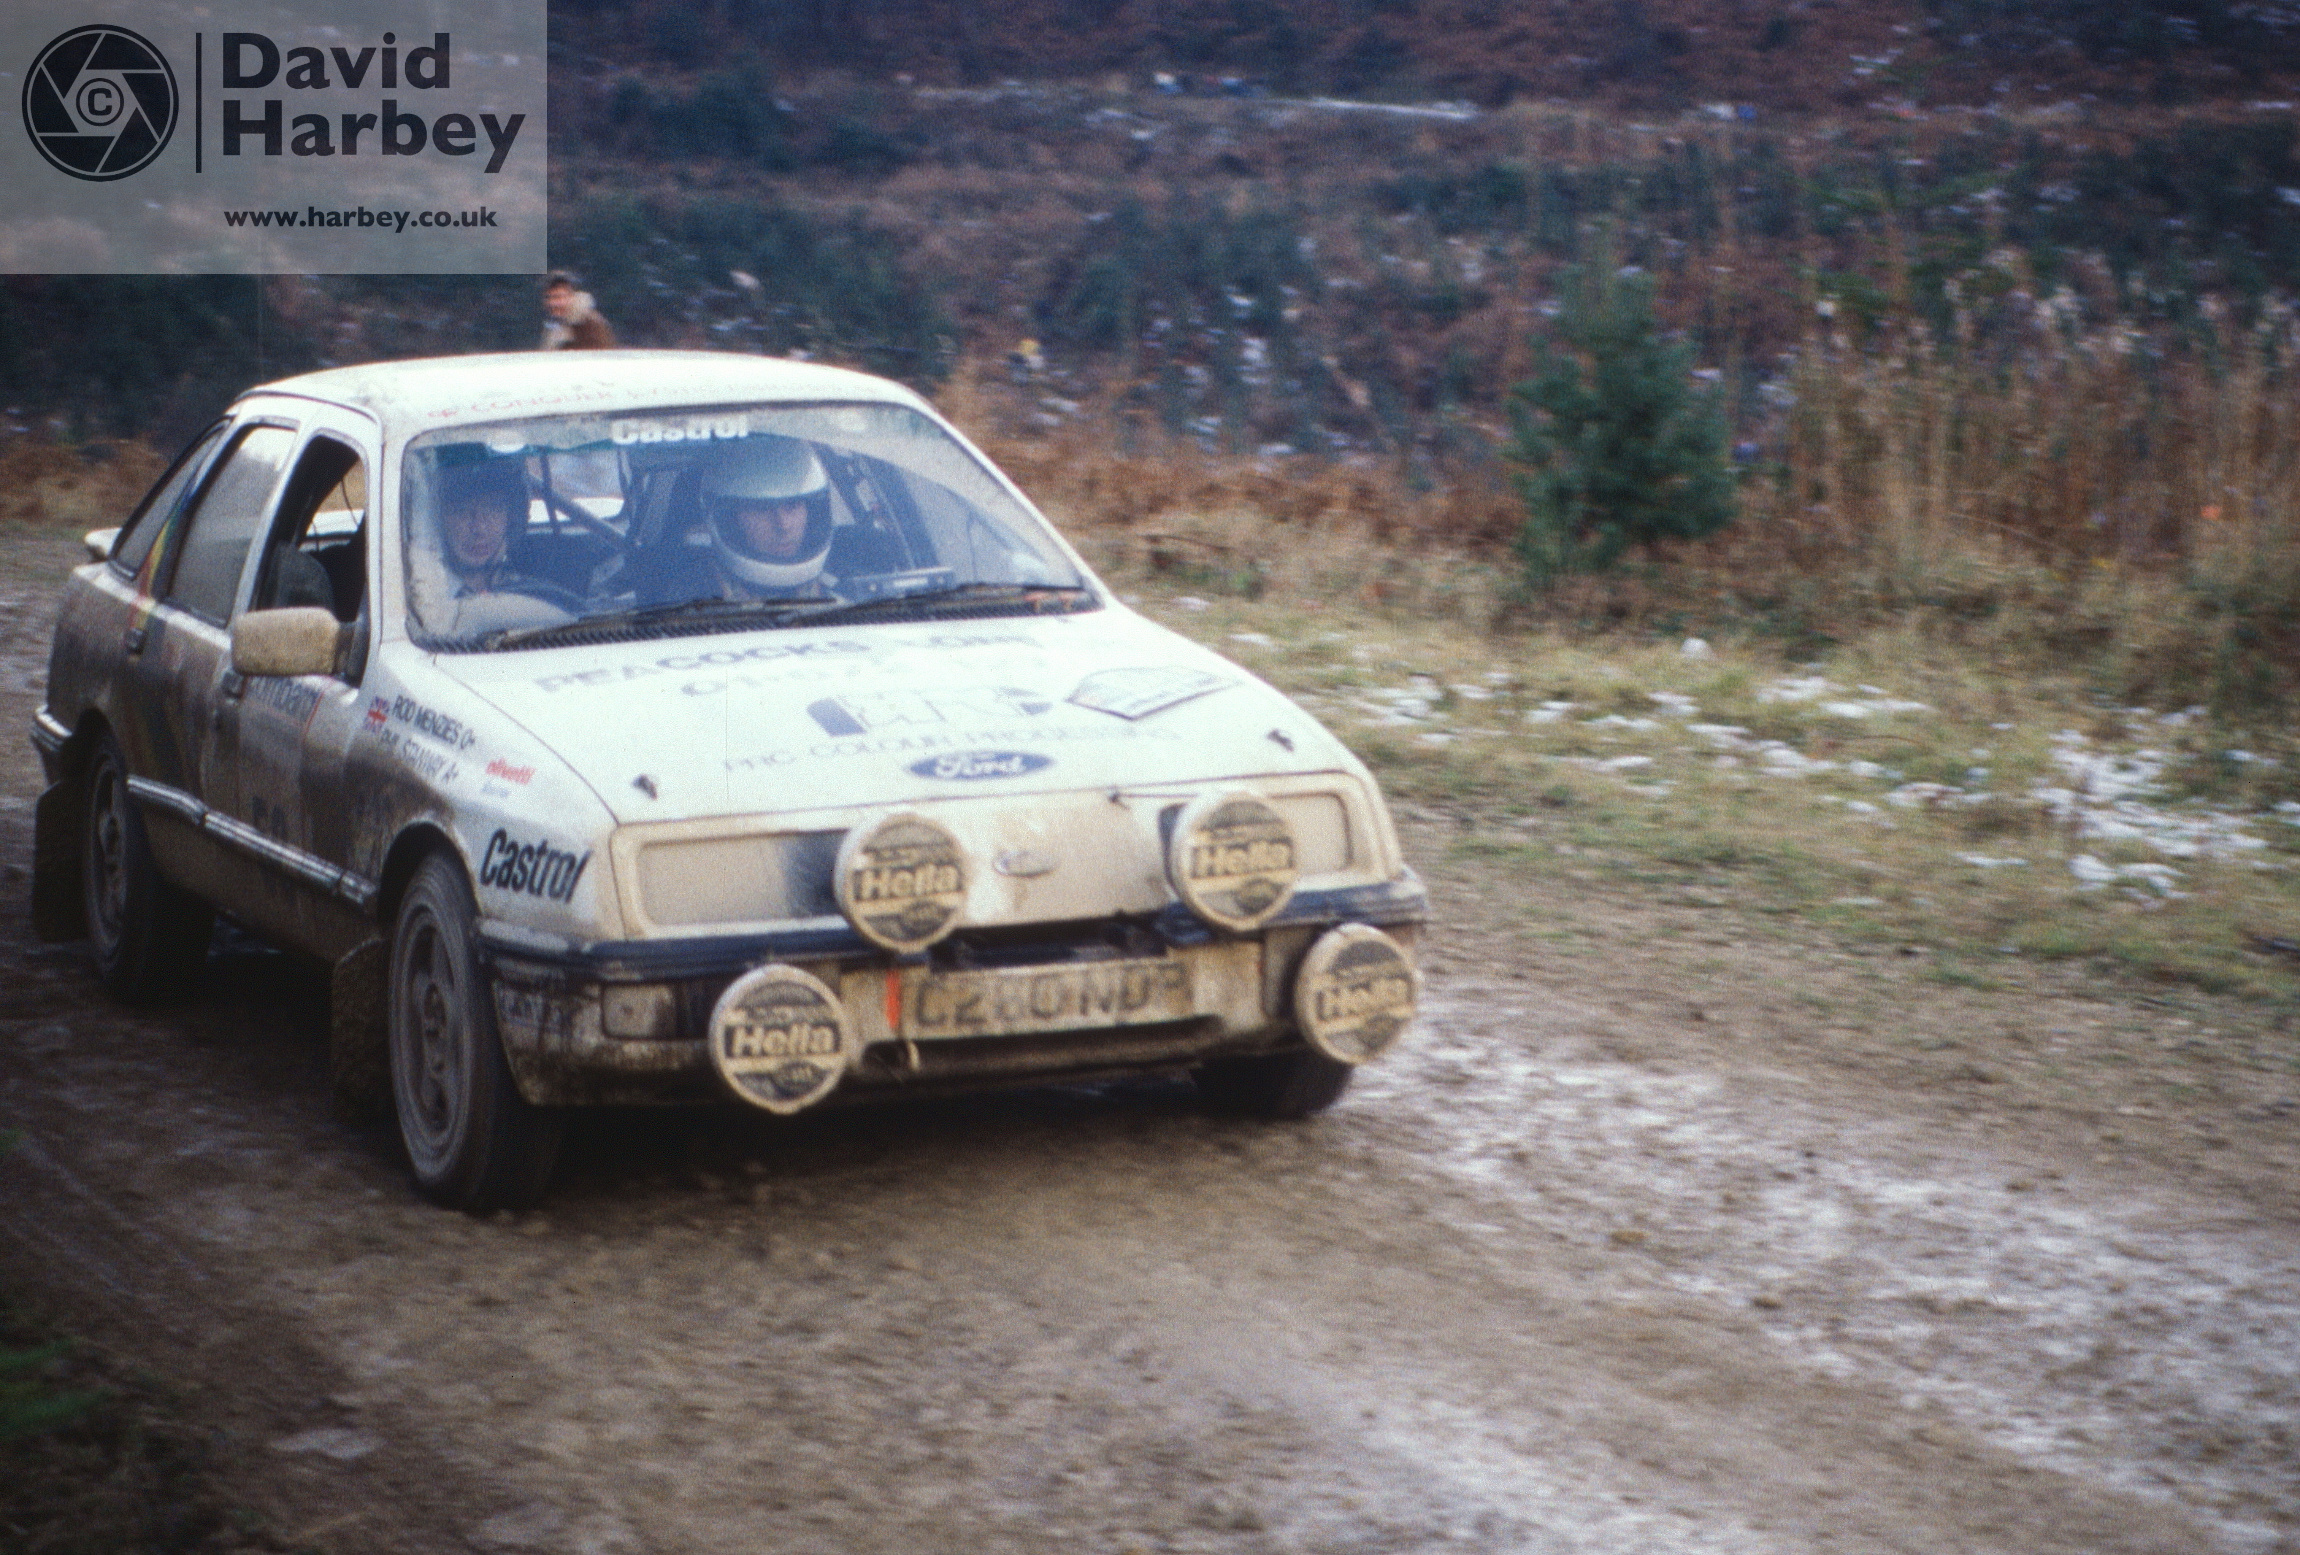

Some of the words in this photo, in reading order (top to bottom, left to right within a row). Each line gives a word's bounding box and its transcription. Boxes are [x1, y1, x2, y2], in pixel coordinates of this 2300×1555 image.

[532, 640, 872, 693] PEACOCKS
[933, 752, 1024, 779] Ford
[480, 827, 596, 904] Castrol
[1198, 838, 1290, 877] Hella
[859, 860, 959, 899] Hella
[733, 1021, 836, 1056] Hella
